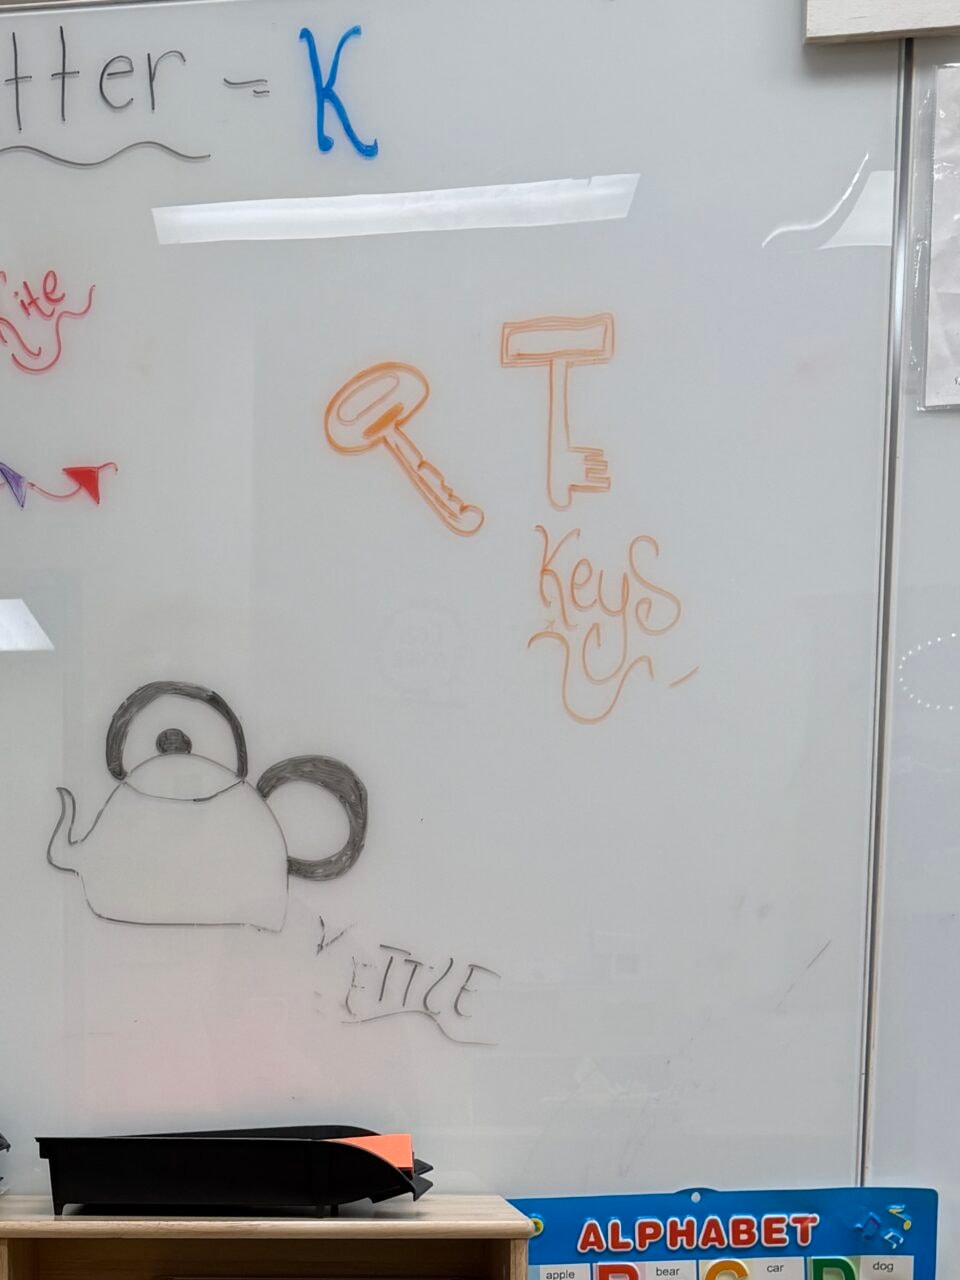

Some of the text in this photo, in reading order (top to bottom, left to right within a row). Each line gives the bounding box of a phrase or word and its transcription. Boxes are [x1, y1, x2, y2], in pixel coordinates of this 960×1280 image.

[298, 23, 380, 161] K
[535, 525, 682, 685] Keys
[577, 1213, 820, 1254] ALPHABET
[656, 1267, 679, 1276] bear
[767, 1263, 784, 1273] car
[872, 1261, 894, 1273] dog
[546, 1270, 575, 1280] apple
